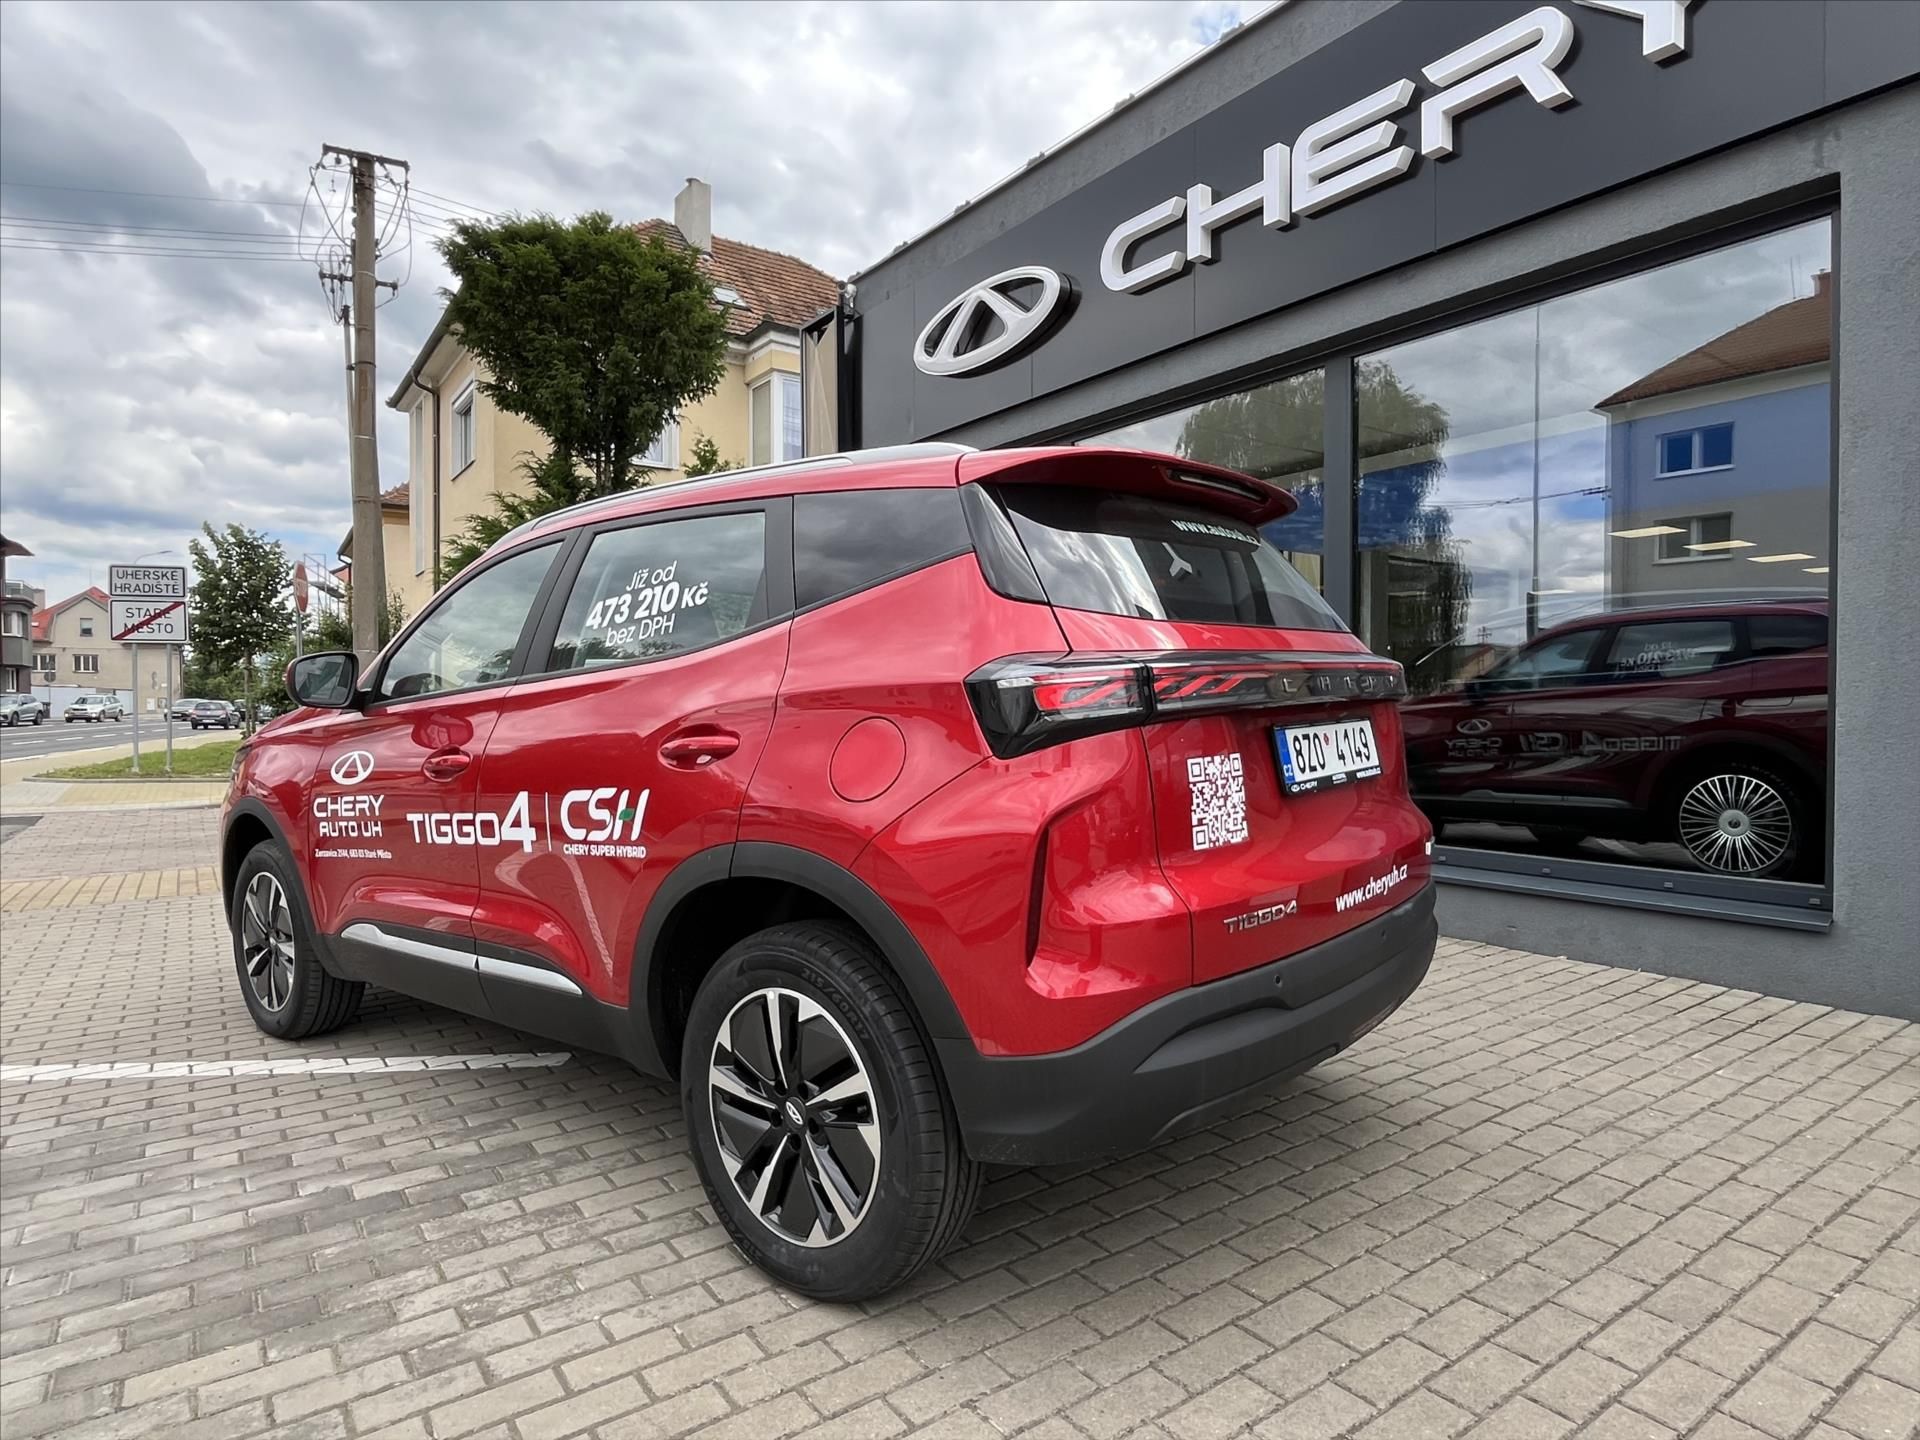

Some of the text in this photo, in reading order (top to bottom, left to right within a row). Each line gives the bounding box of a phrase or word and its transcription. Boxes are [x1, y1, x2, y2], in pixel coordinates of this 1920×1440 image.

[114, 580, 180, 594] HRADIŠTĚ
[116, 569, 179, 580] UHERSKÉ
[626, 560, 677, 591] Již od
[585, 581, 709, 630] 473 210 Kč
[605, 613, 676, 647] bez DPH
[1335, 727, 1371, 766] 4149
[1283, 764, 1294, 776] CZ
[313, 794, 385, 817] CHERY
[560, 787, 650, 841] CSH
[319, 821, 383, 837] AUTO UH
[563, 843, 647, 859] CHERY SUPER HYBRID
[1335, 863, 1408, 912] www.cheryuh.cz
